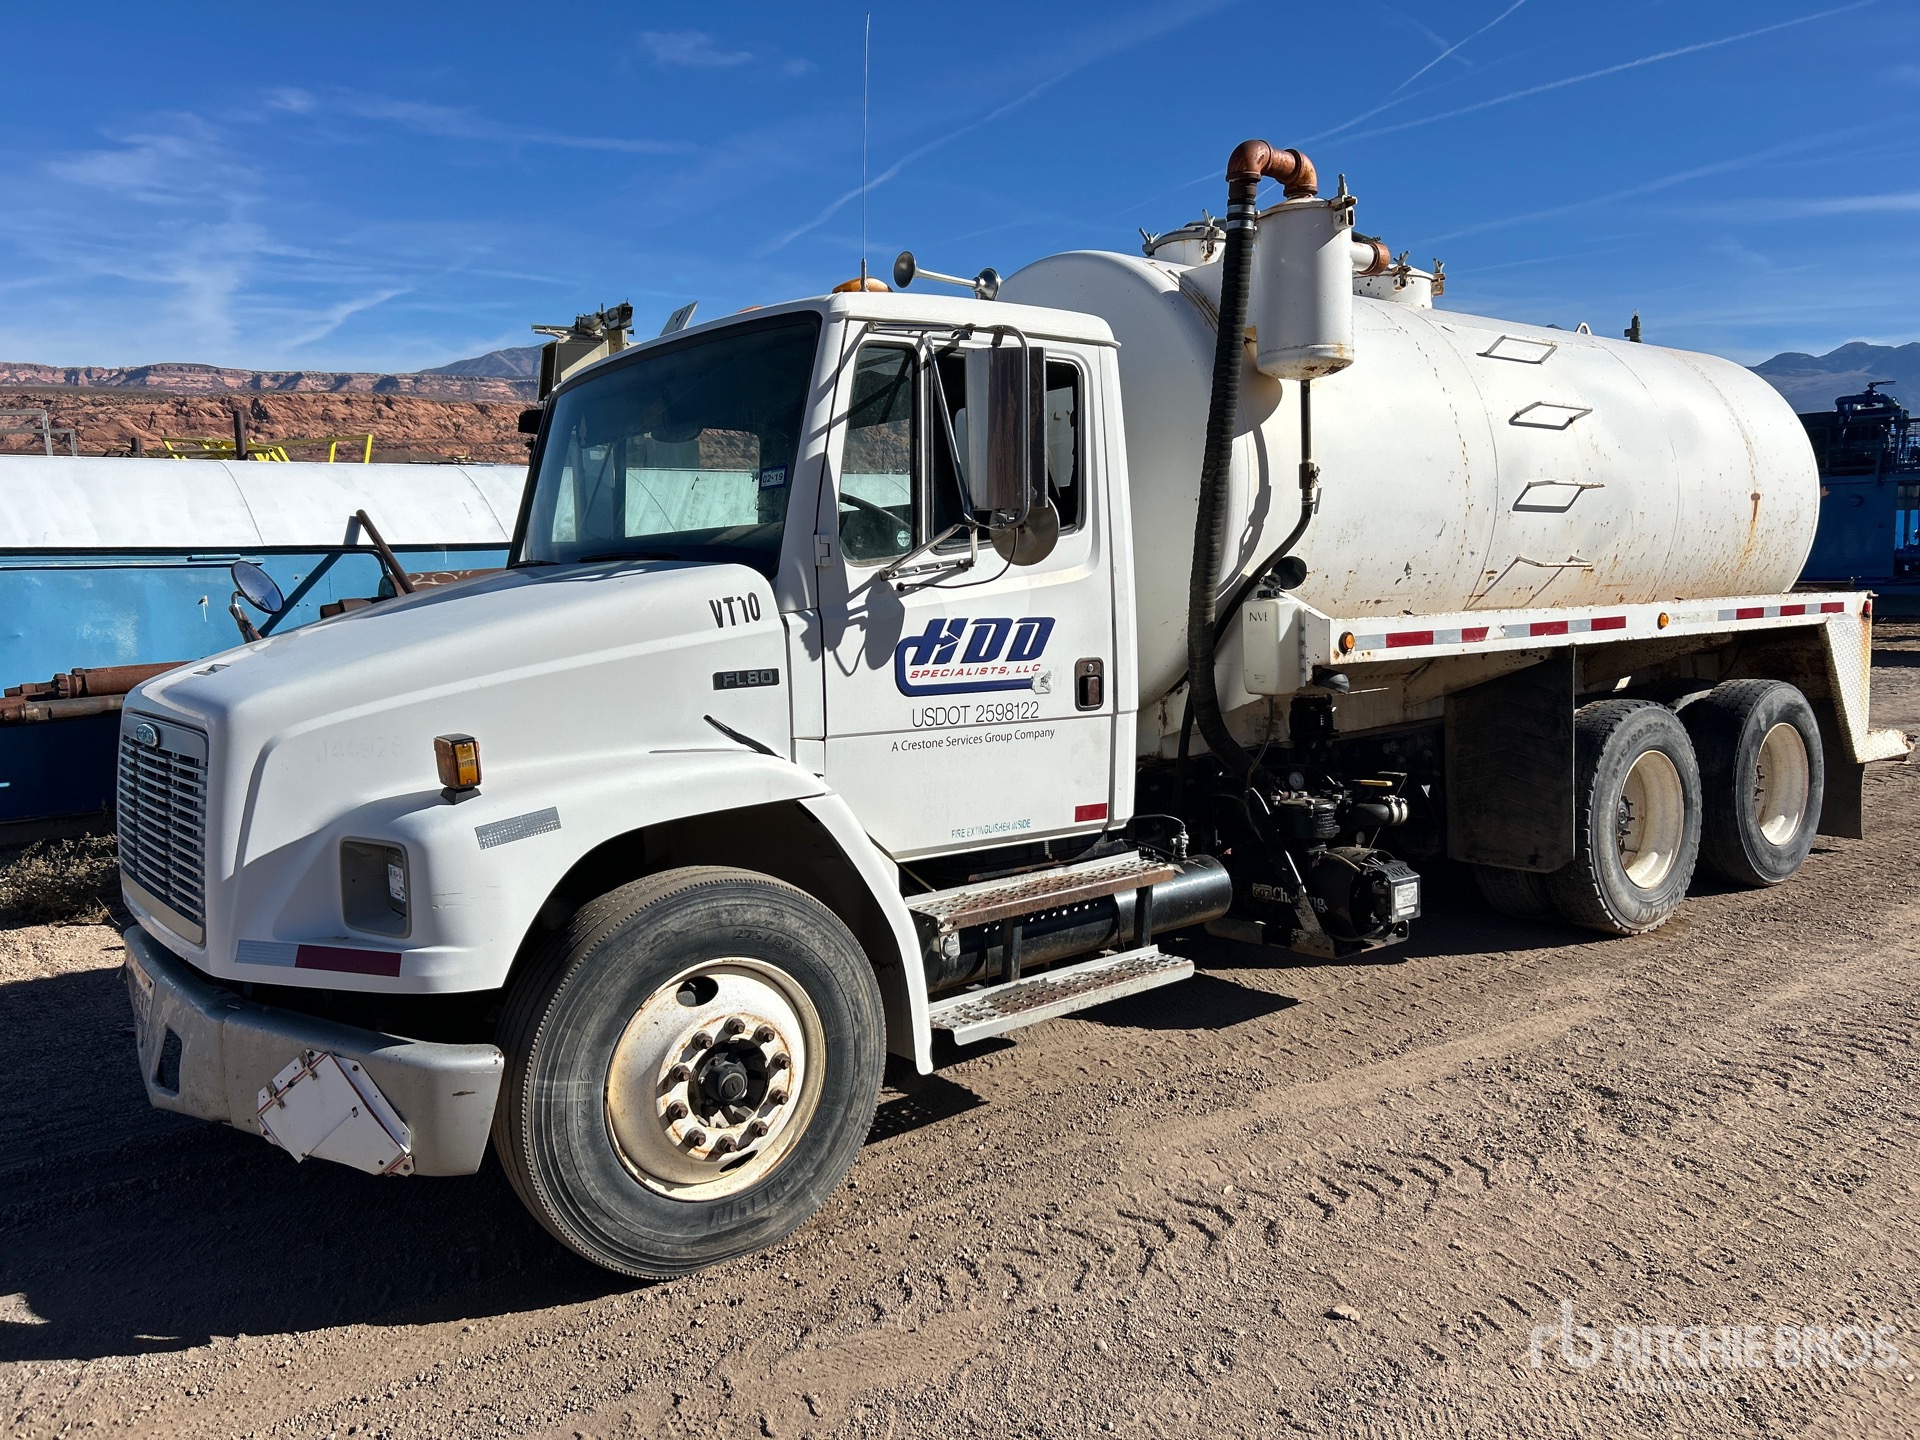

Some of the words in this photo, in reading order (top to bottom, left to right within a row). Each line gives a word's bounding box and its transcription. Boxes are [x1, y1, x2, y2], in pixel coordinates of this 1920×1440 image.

[708, 592, 761, 629] VT10
[909, 616, 1056, 666] HDD
[722, 670, 773, 687] FL80
[909, 665, 1010, 679] SPECIALISTS,
[1015, 663, 1041, 674] LLC
[912, 705, 971, 728] USDOT
[975, 701, 1040, 723] 2598122
[891, 741, 899, 752] A
[901, 739, 944, 751] Crestone
[945, 734, 983, 747] Services
[984, 731, 1013, 743] Group
[1014, 728, 1056, 741] Company
[951, 828, 966, 839] FIRE
[966, 821, 1011, 837] EXTINGUISHER
